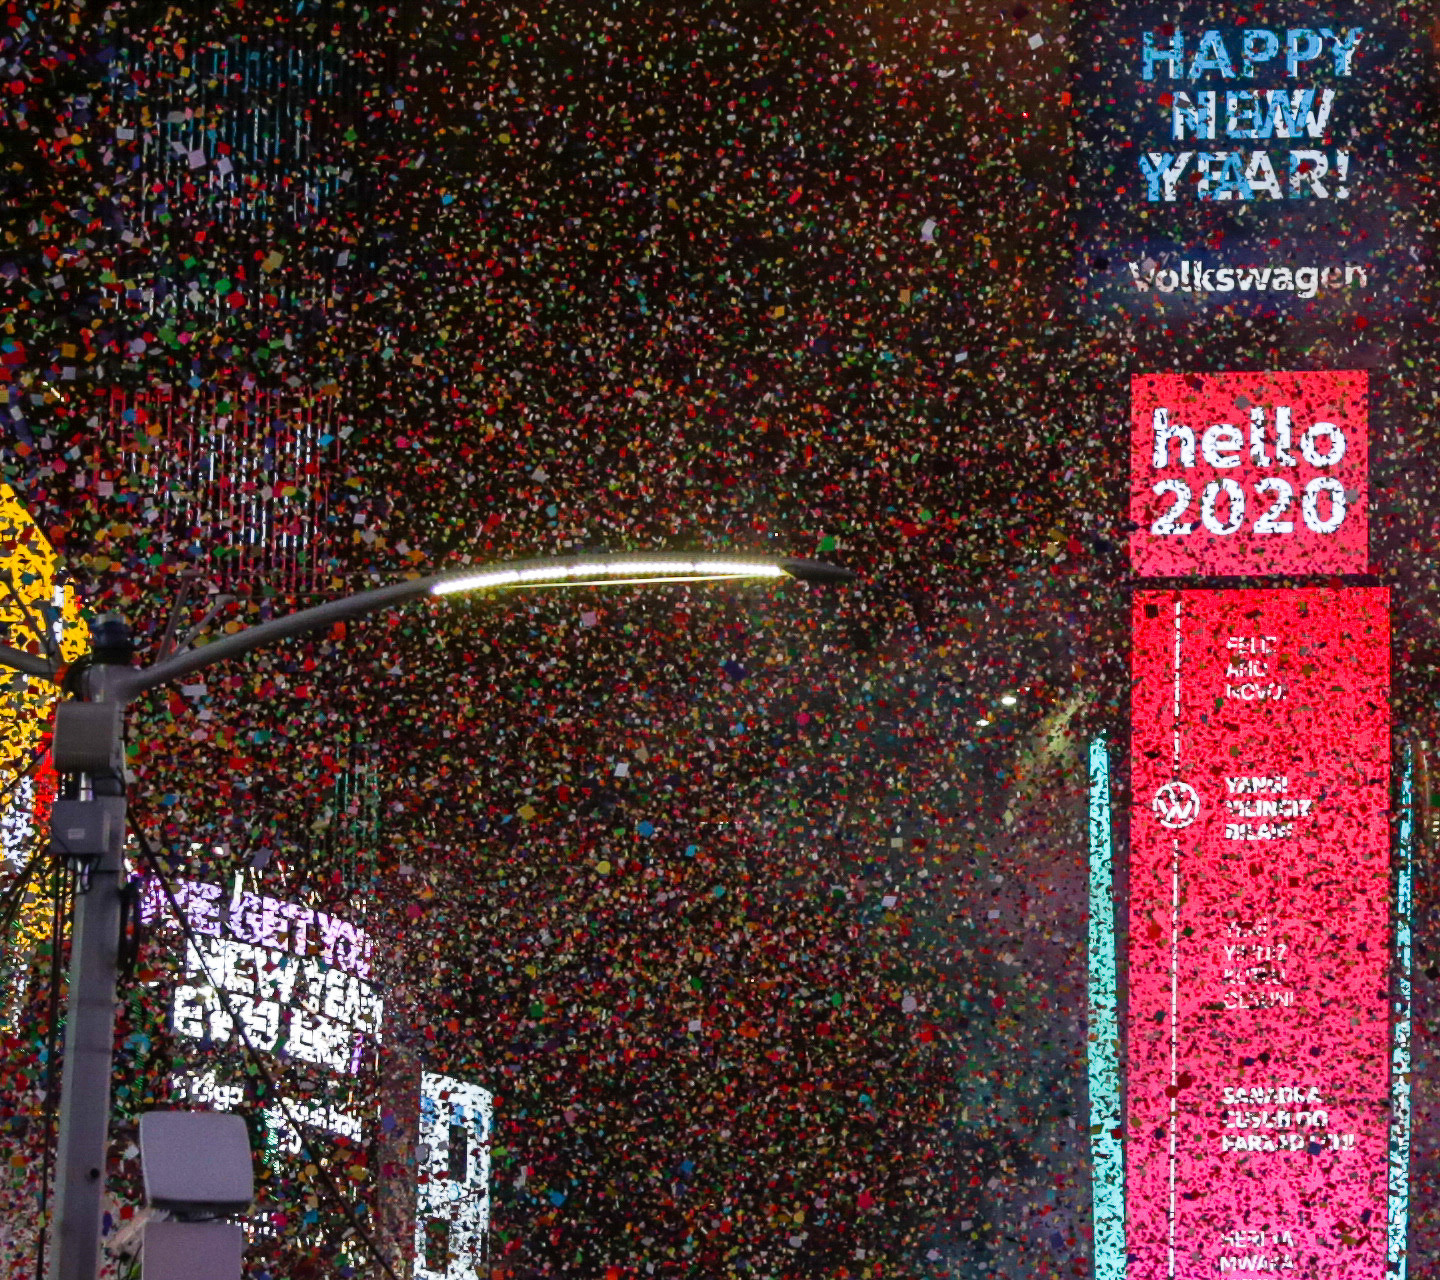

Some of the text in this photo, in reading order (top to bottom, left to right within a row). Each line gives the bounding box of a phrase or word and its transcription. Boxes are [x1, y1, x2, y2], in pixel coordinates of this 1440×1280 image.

[1142, 27, 1363, 81] HAPPY
[1172, 89, 1336, 140] NEW
[1138, 149, 1350, 202] YEAR!
[1128, 260, 1368, 299] Volkswagen
[1153, 406, 1347, 469] hello
[1151, 477, 1347, 535] 2020
